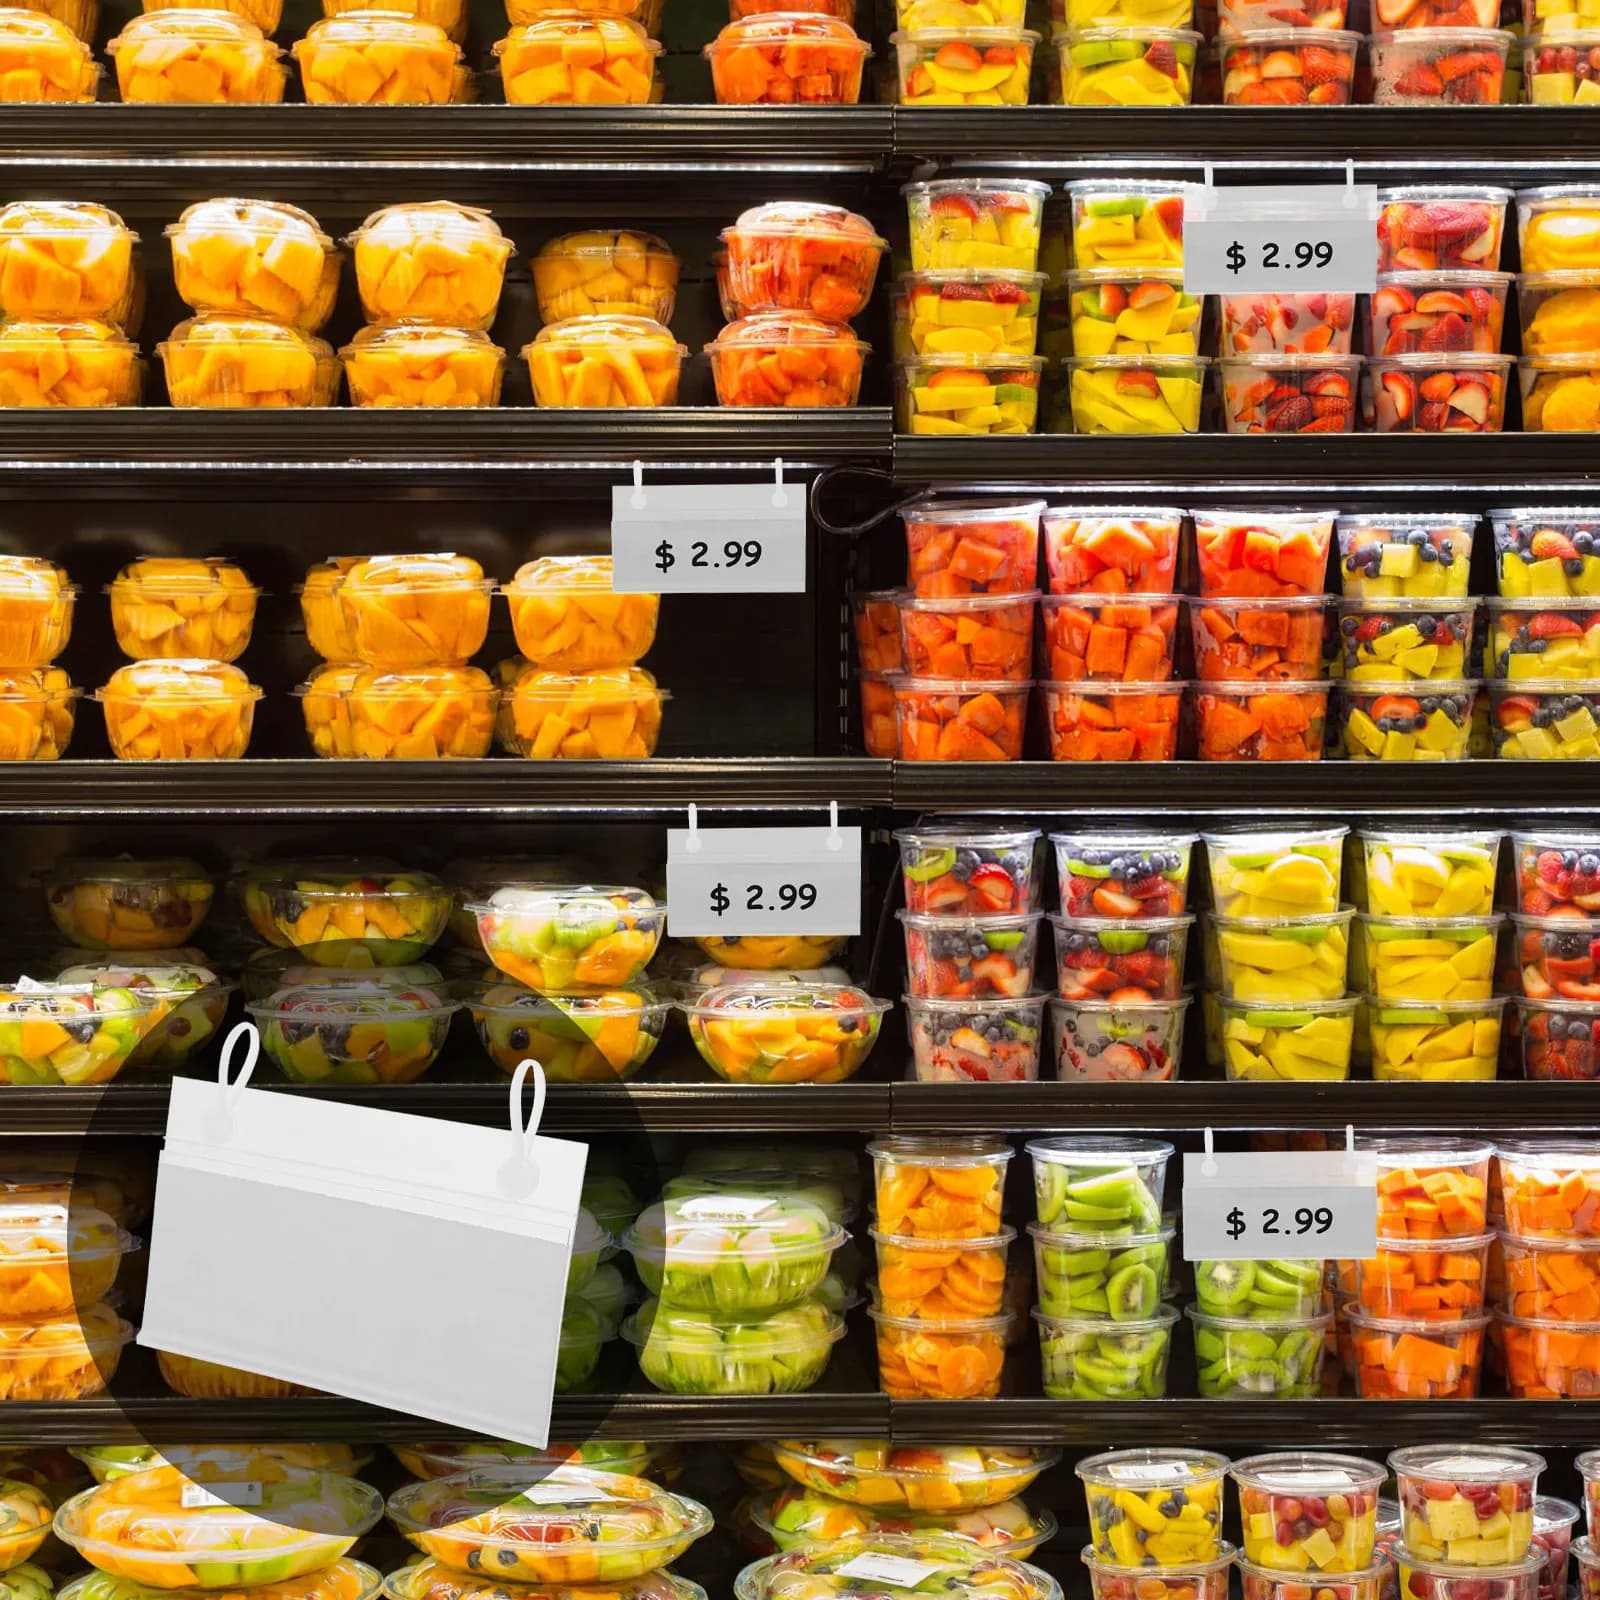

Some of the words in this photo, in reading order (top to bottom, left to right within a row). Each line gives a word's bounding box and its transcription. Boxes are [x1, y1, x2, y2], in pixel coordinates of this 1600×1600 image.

[1225, 240, 1247, 275] $
[1262, 241, 1333, 269] 2.99
[655, 539, 676, 574] $
[691, 540, 763, 568] 2.99
[709, 882, 731, 917] $
[746, 883, 818, 911] 2.99
[1225, 1206, 1247, 1241] $
[1262, 1207, 1334, 1235] 2.99
